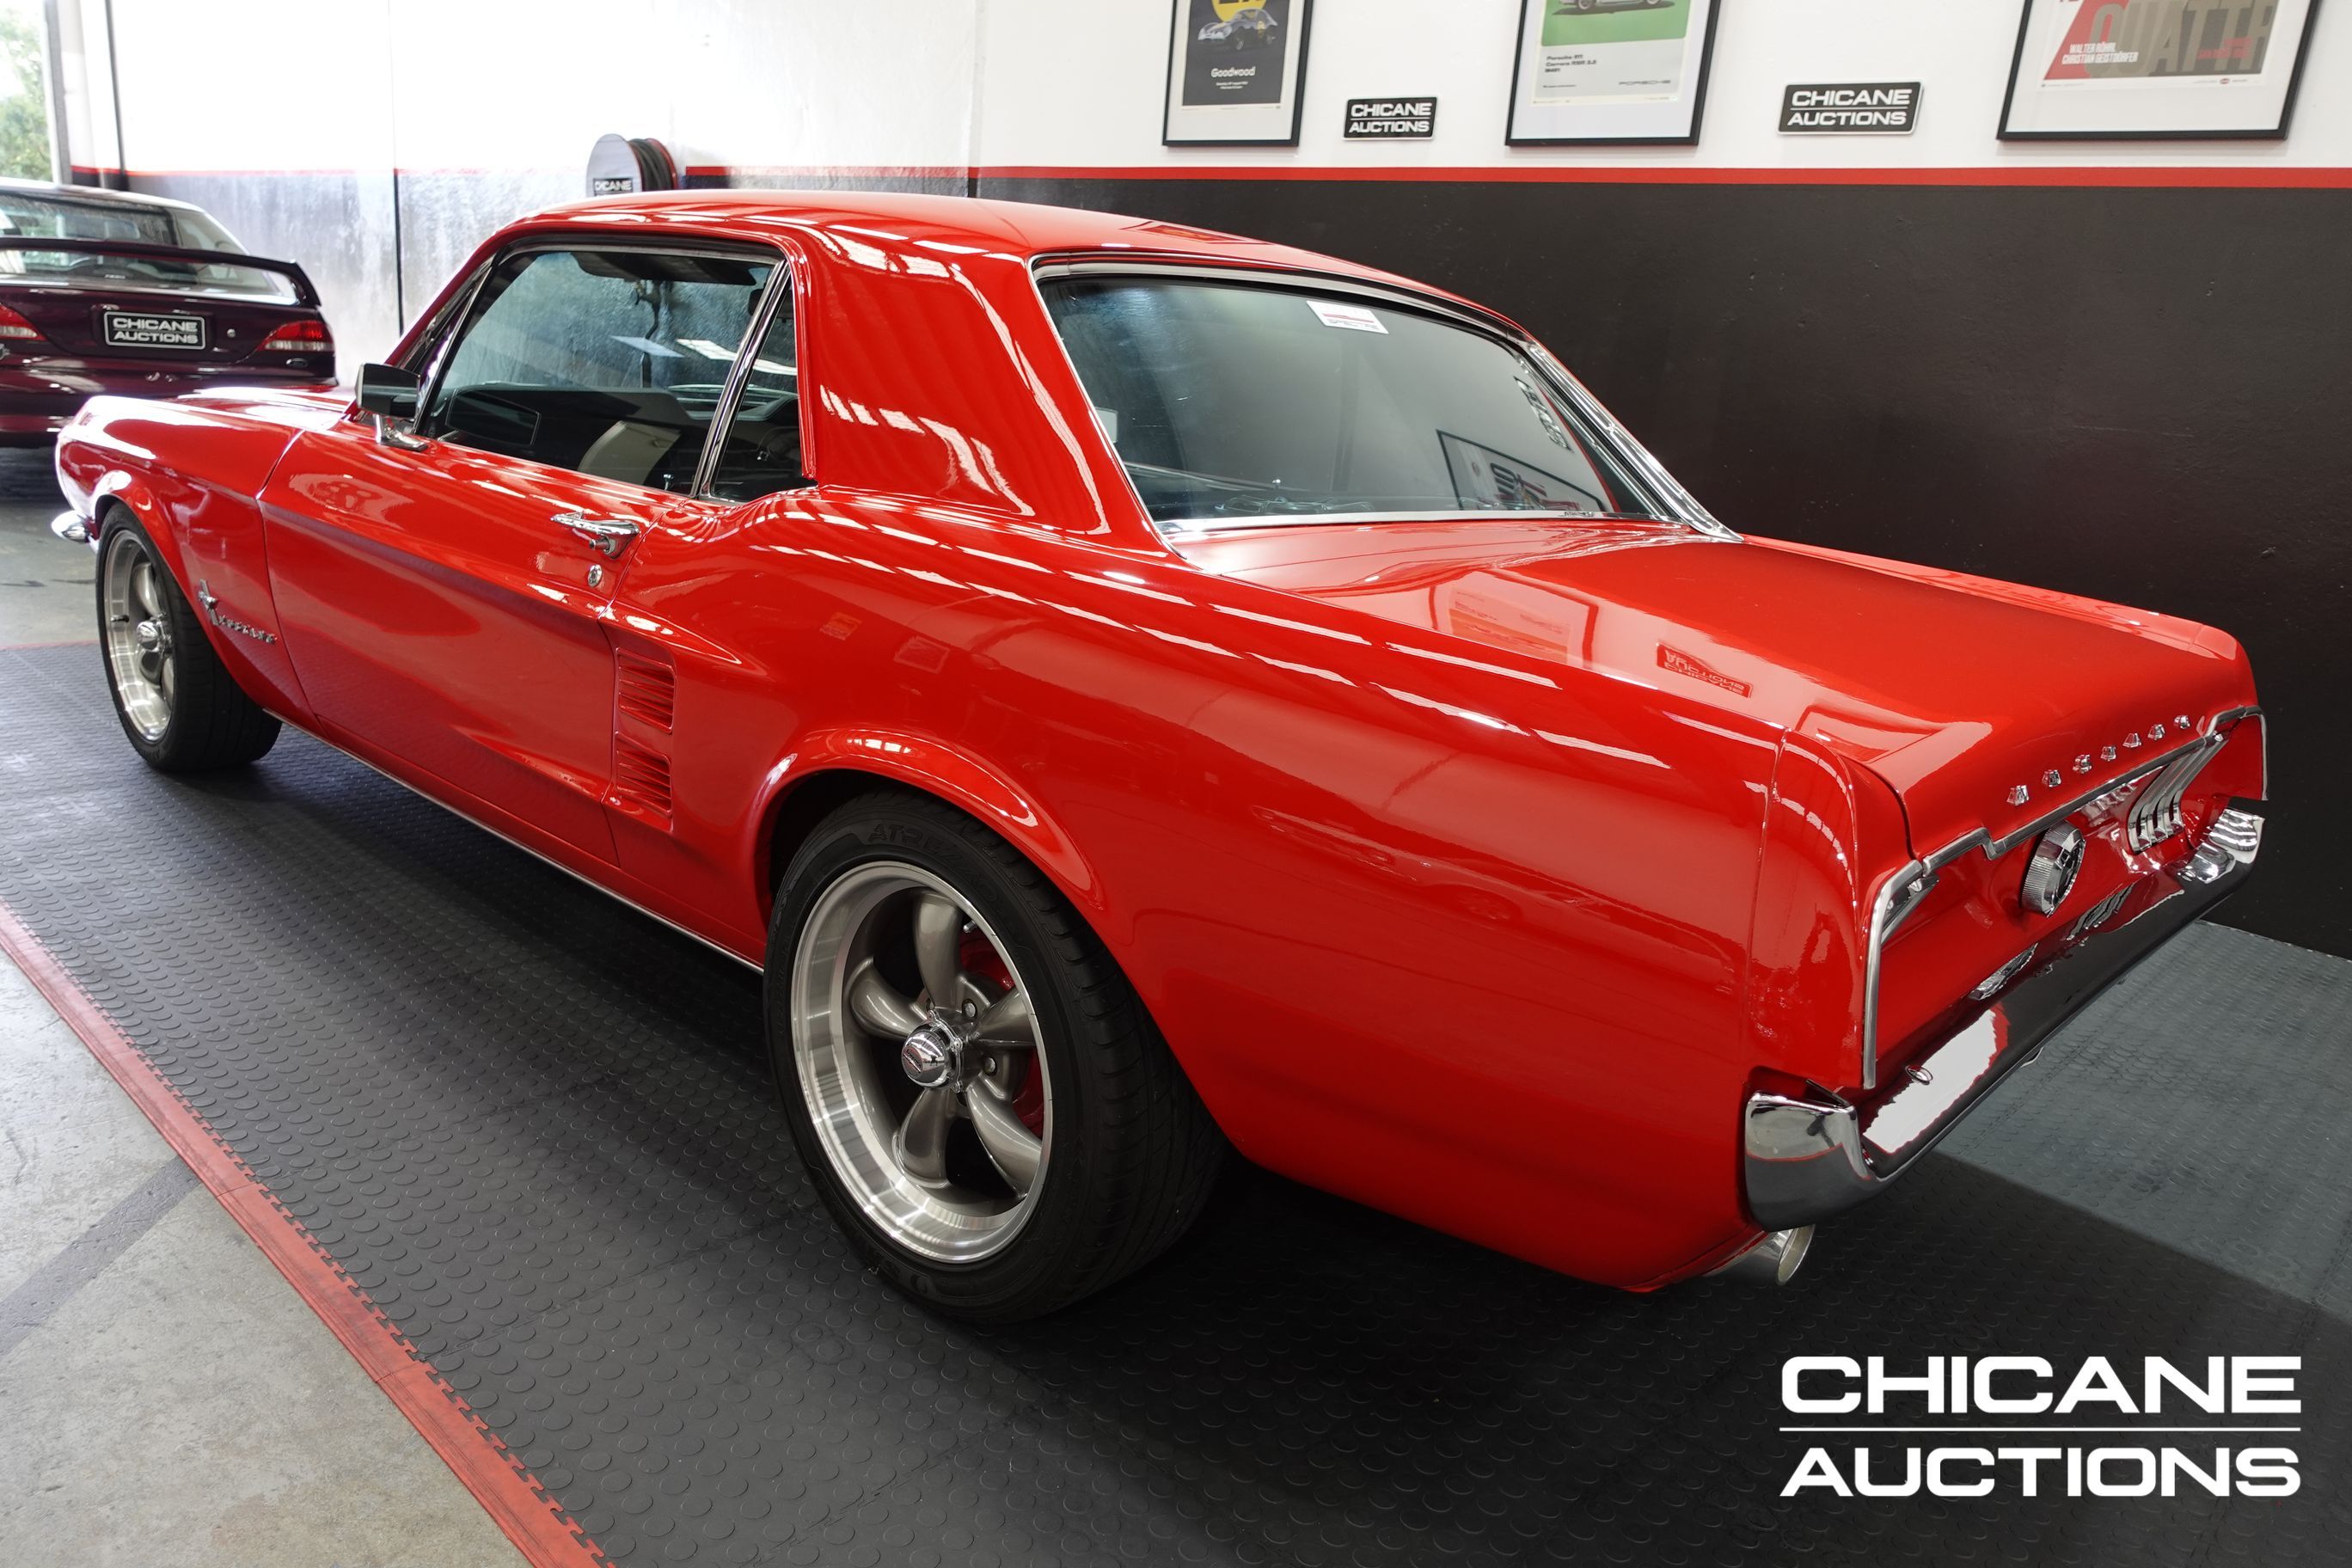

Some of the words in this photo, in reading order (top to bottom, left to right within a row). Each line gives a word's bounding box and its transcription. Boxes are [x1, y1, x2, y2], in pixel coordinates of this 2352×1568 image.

[2069, 43, 2096, 53] WALTER
[2061, 52, 2095, 64] CHRISTIAN
[1210, 65, 1256, 78] Goodwood
[1792, 89, 1913, 107] CHICANE
[1350, 101, 1433, 118] CHICANE
[1787, 111, 1908, 126] AUCTIONS
[1348, 120, 1430, 134] AUCTIONS
[113, 317, 198, 333] CHICANE
[113, 330, 199, 344] AUCTIONS
